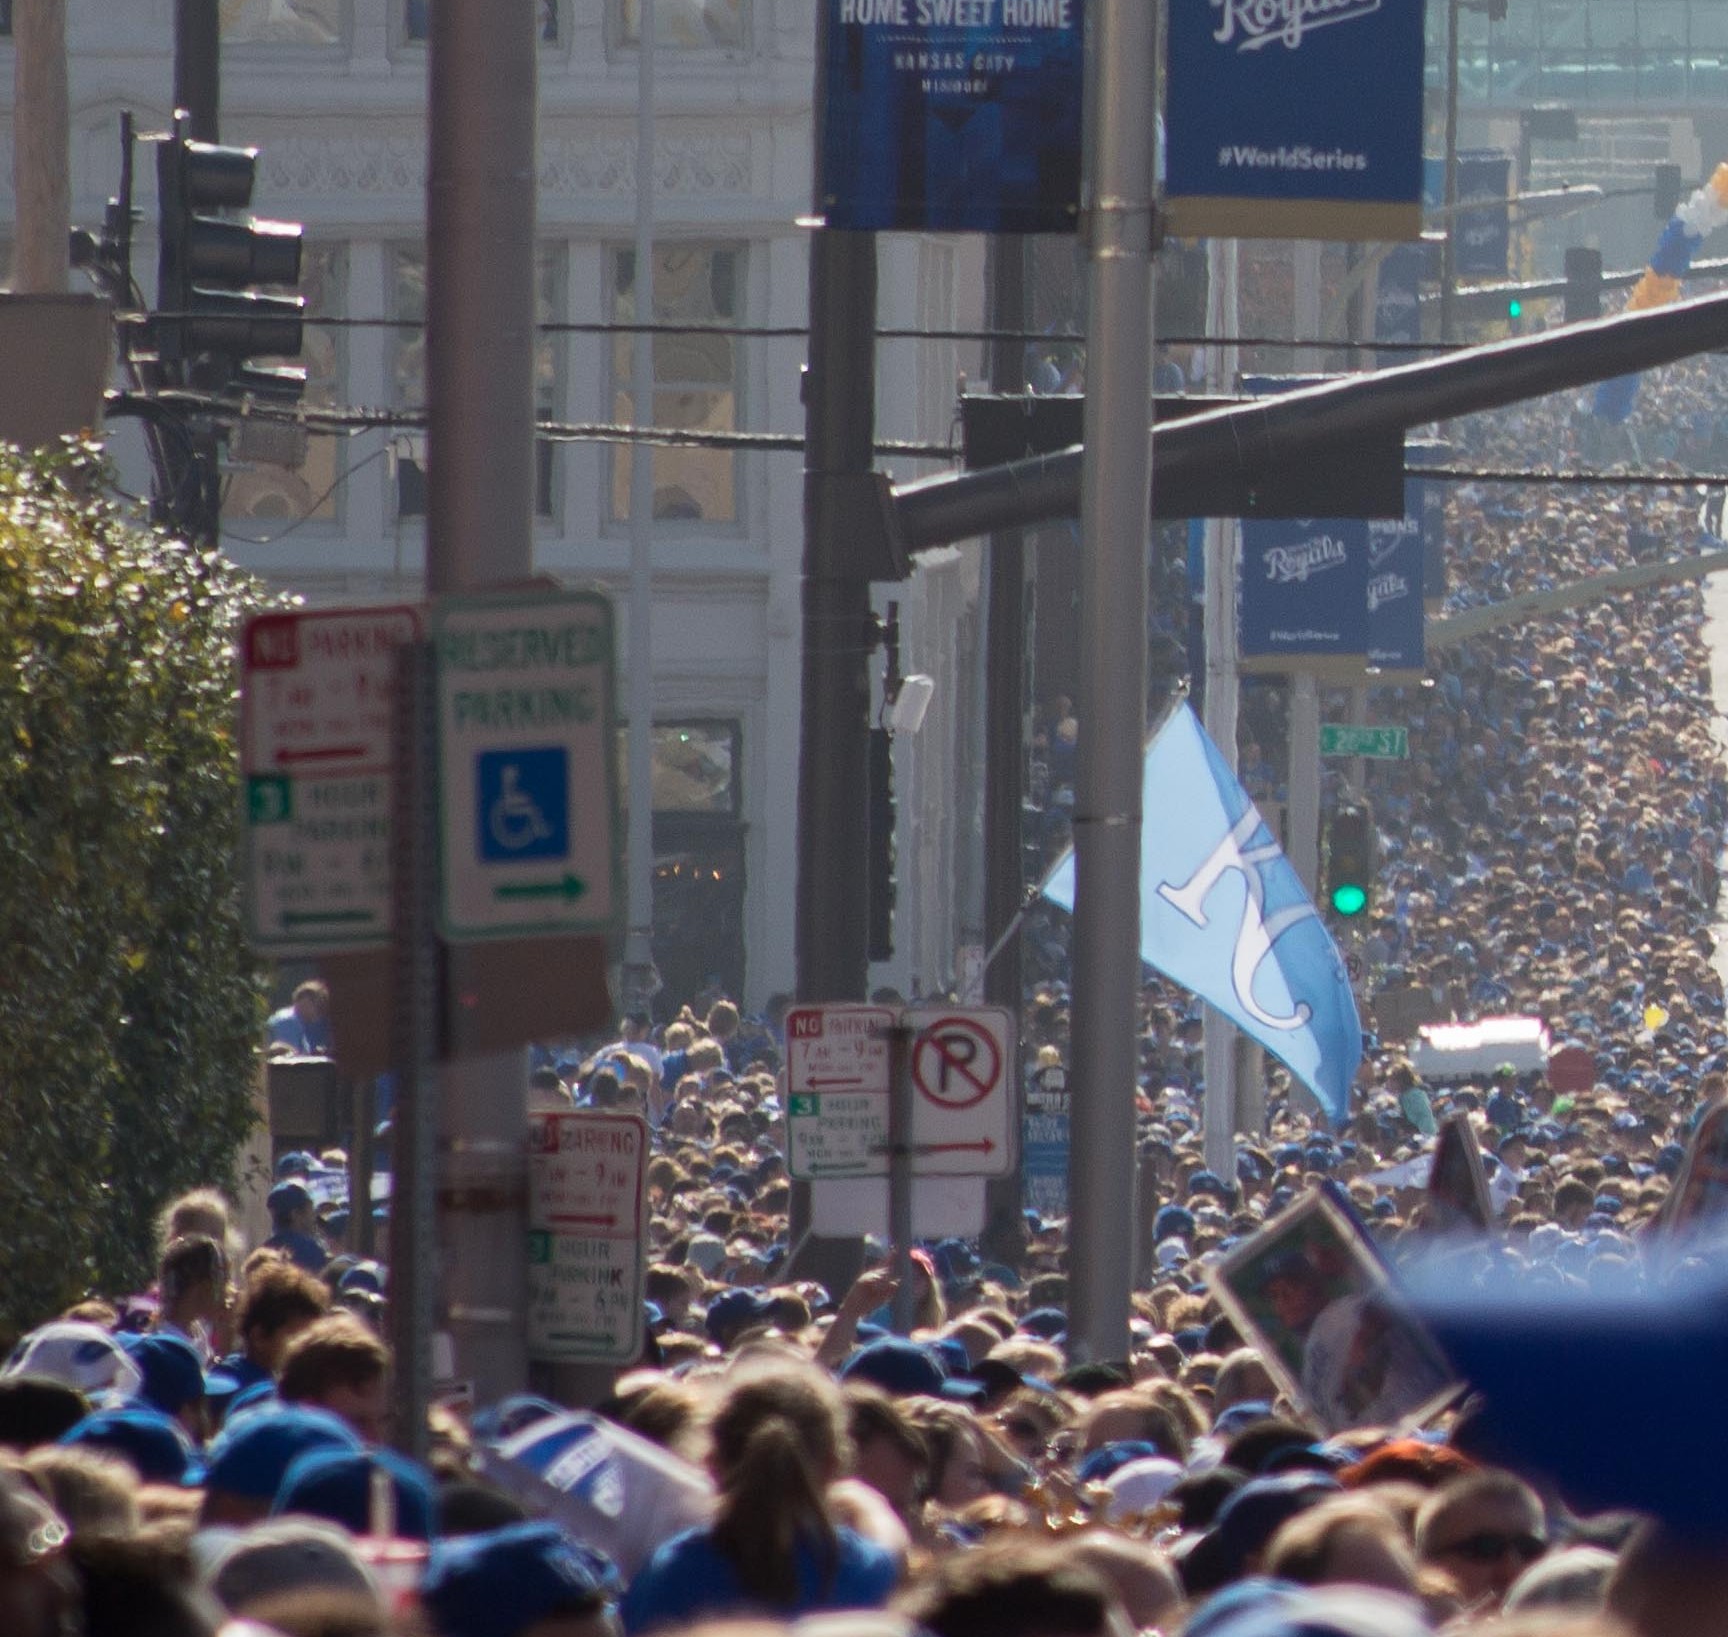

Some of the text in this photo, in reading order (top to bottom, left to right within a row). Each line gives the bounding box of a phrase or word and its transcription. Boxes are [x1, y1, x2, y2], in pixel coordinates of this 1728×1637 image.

[894, 53, 965, 70] KANSAS
[1218, 145, 1367, 171] #WorldSeries
[1262, 534, 1347, 583] Royals
[795, 1016, 820, 1036] NO
[796, 1096, 813, 1114] 3
